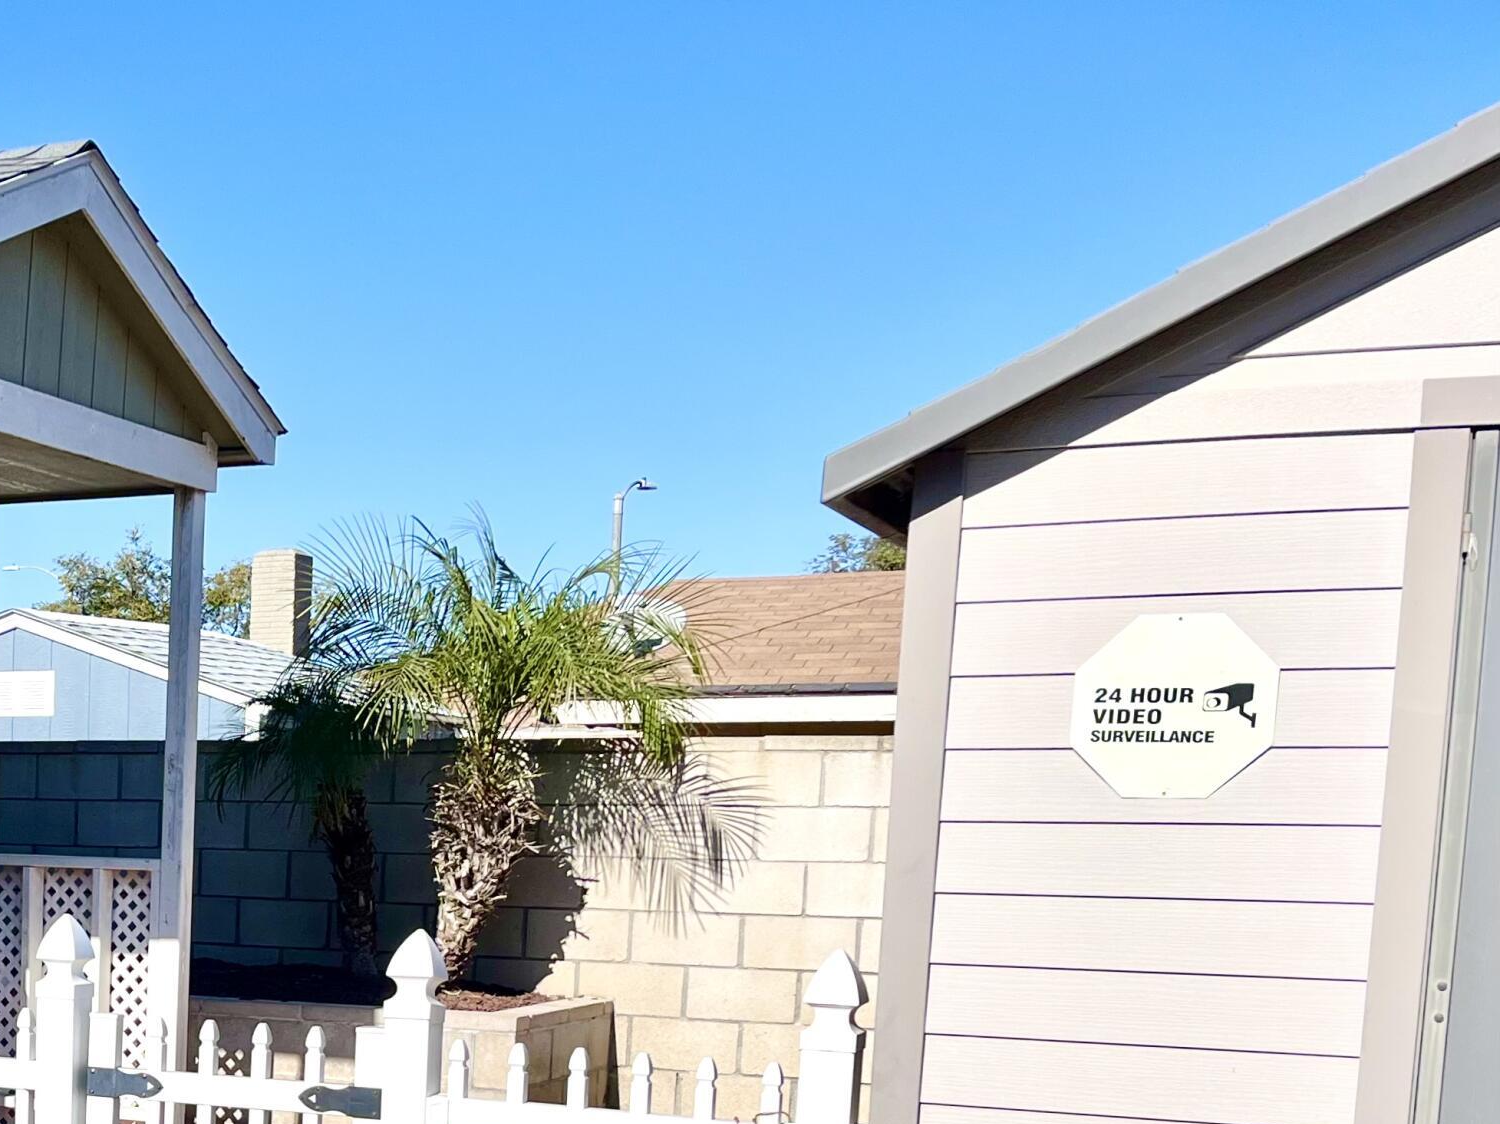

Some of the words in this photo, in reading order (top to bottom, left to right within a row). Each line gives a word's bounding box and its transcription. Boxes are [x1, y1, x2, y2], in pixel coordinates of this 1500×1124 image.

[1094, 687, 1122, 703] 24
[1130, 687, 1194, 704] HOUR
[1093, 708, 1162, 725] VIDEO
[1090, 730, 1215, 743] SURVEILLANCE
